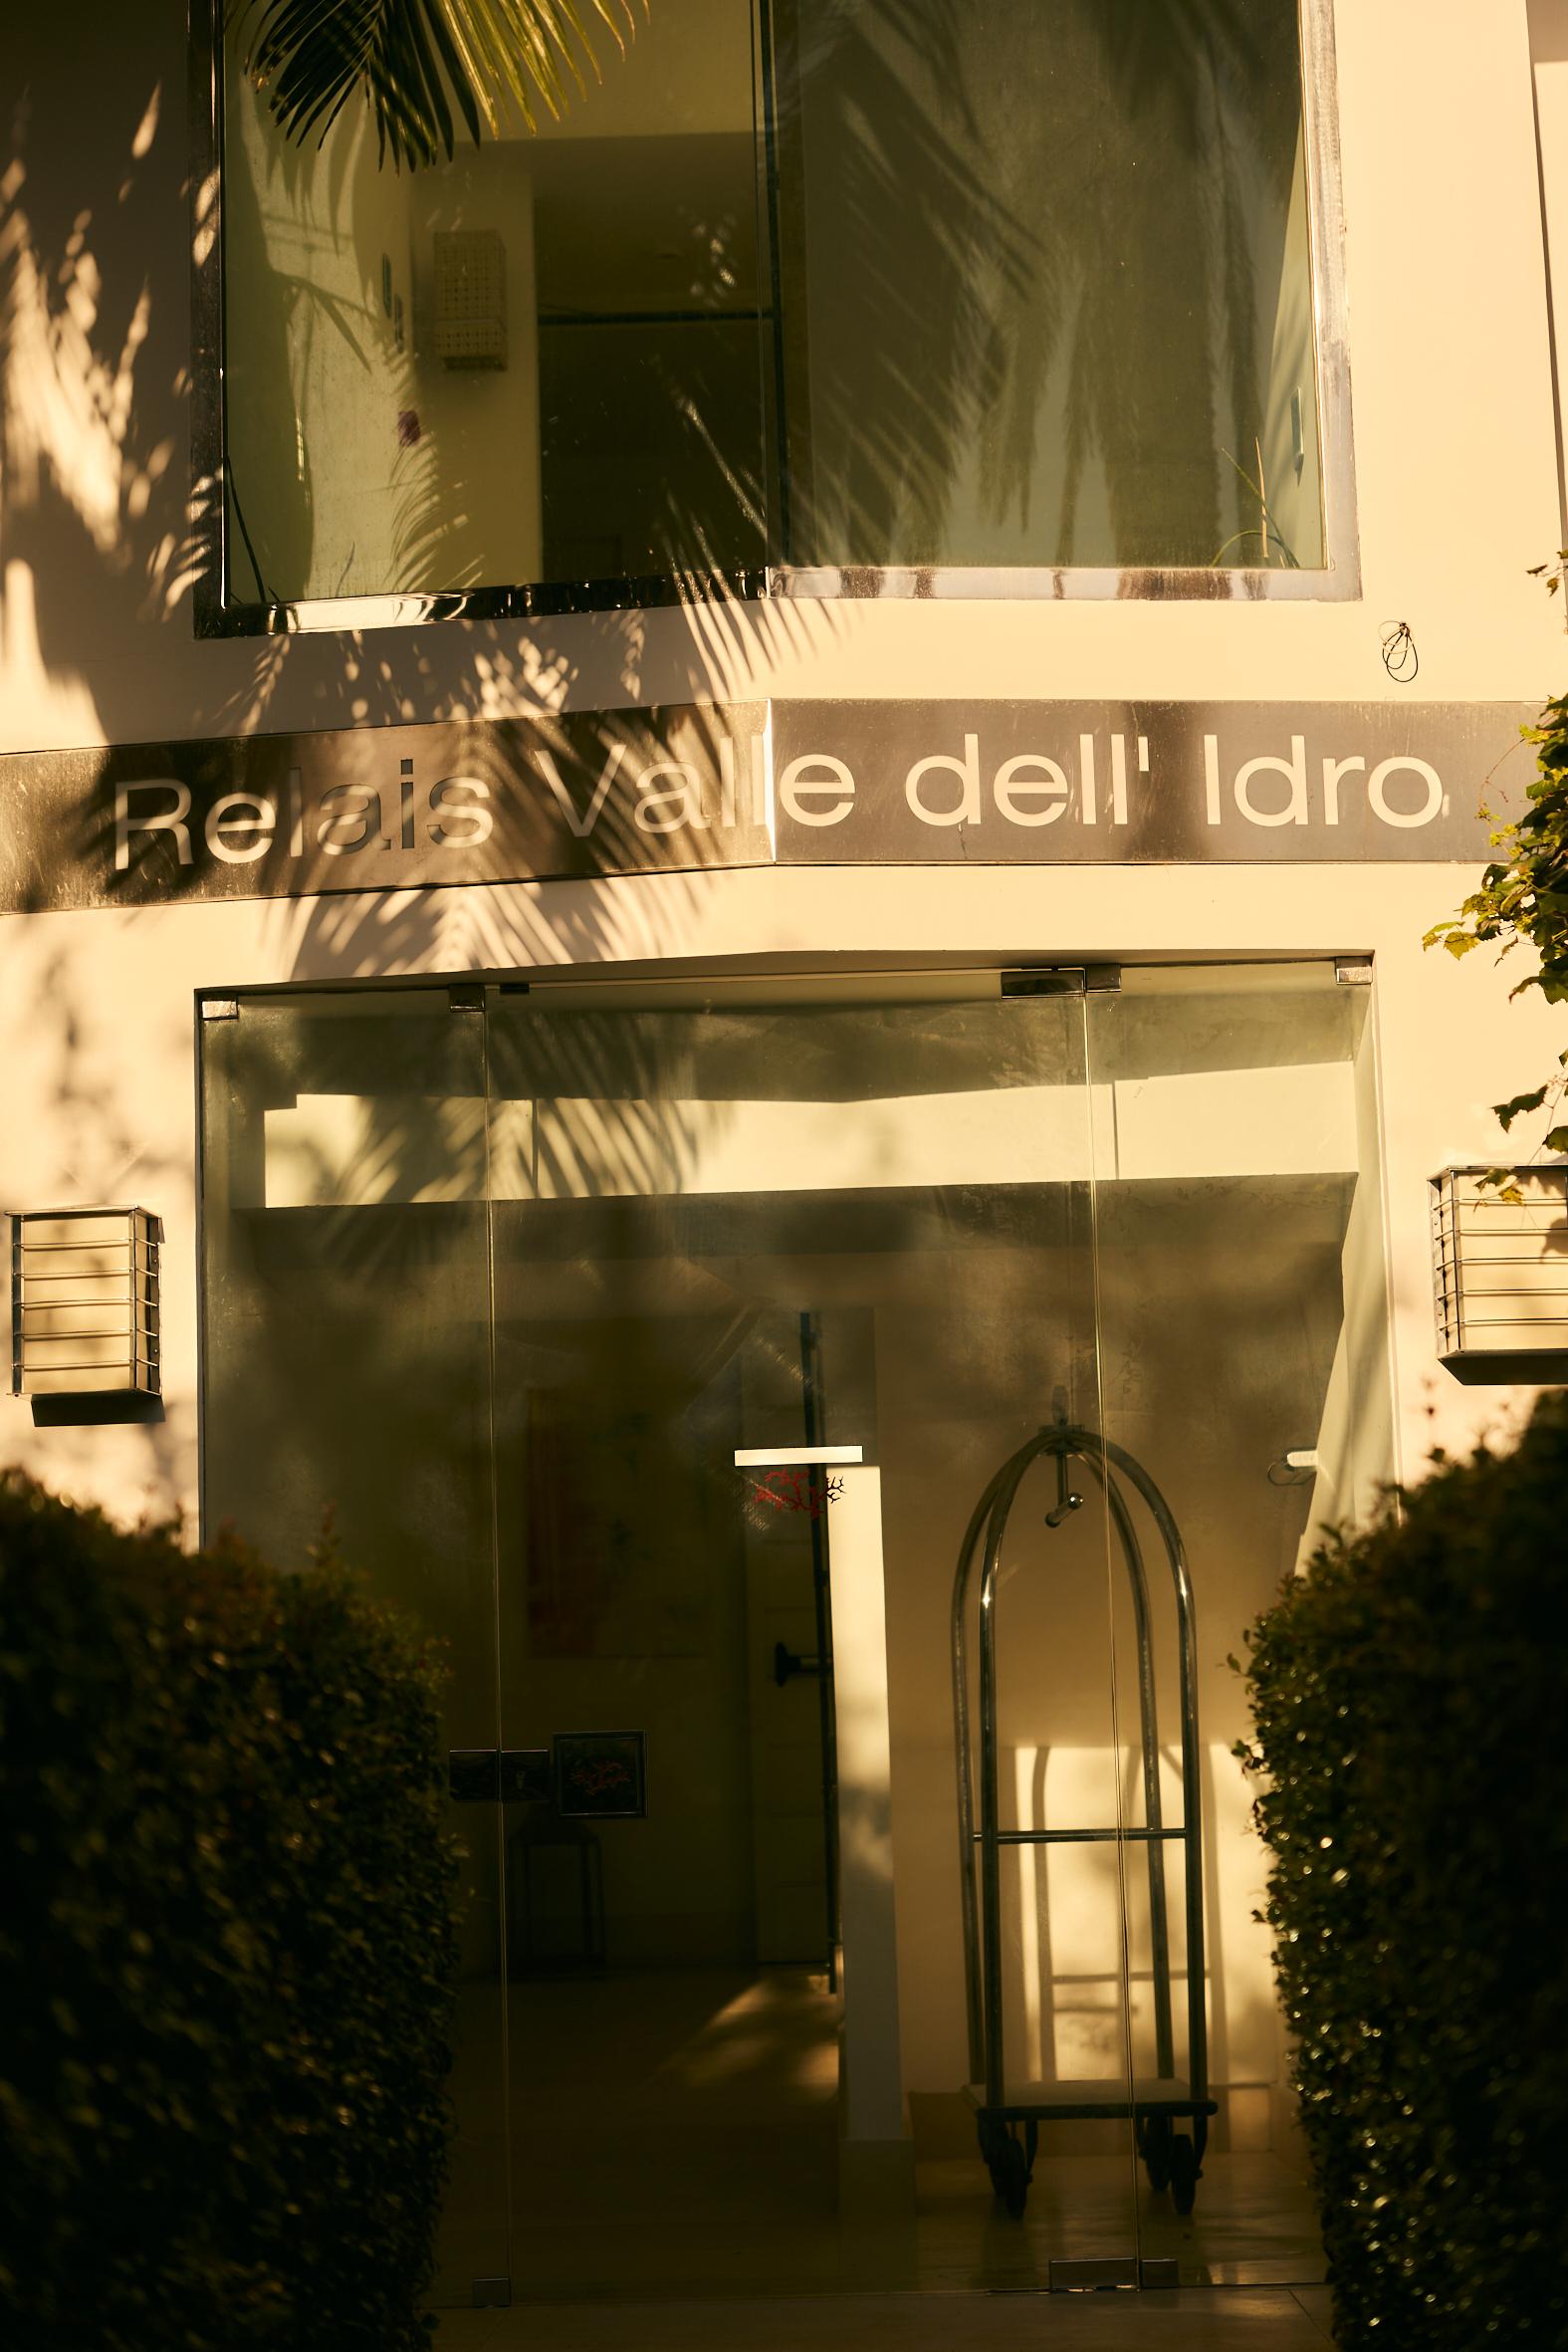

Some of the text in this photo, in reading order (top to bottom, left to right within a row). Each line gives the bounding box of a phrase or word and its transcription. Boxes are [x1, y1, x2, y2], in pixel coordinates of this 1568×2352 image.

[114, 733, 1444, 870] Relais Valle dell' Idro
